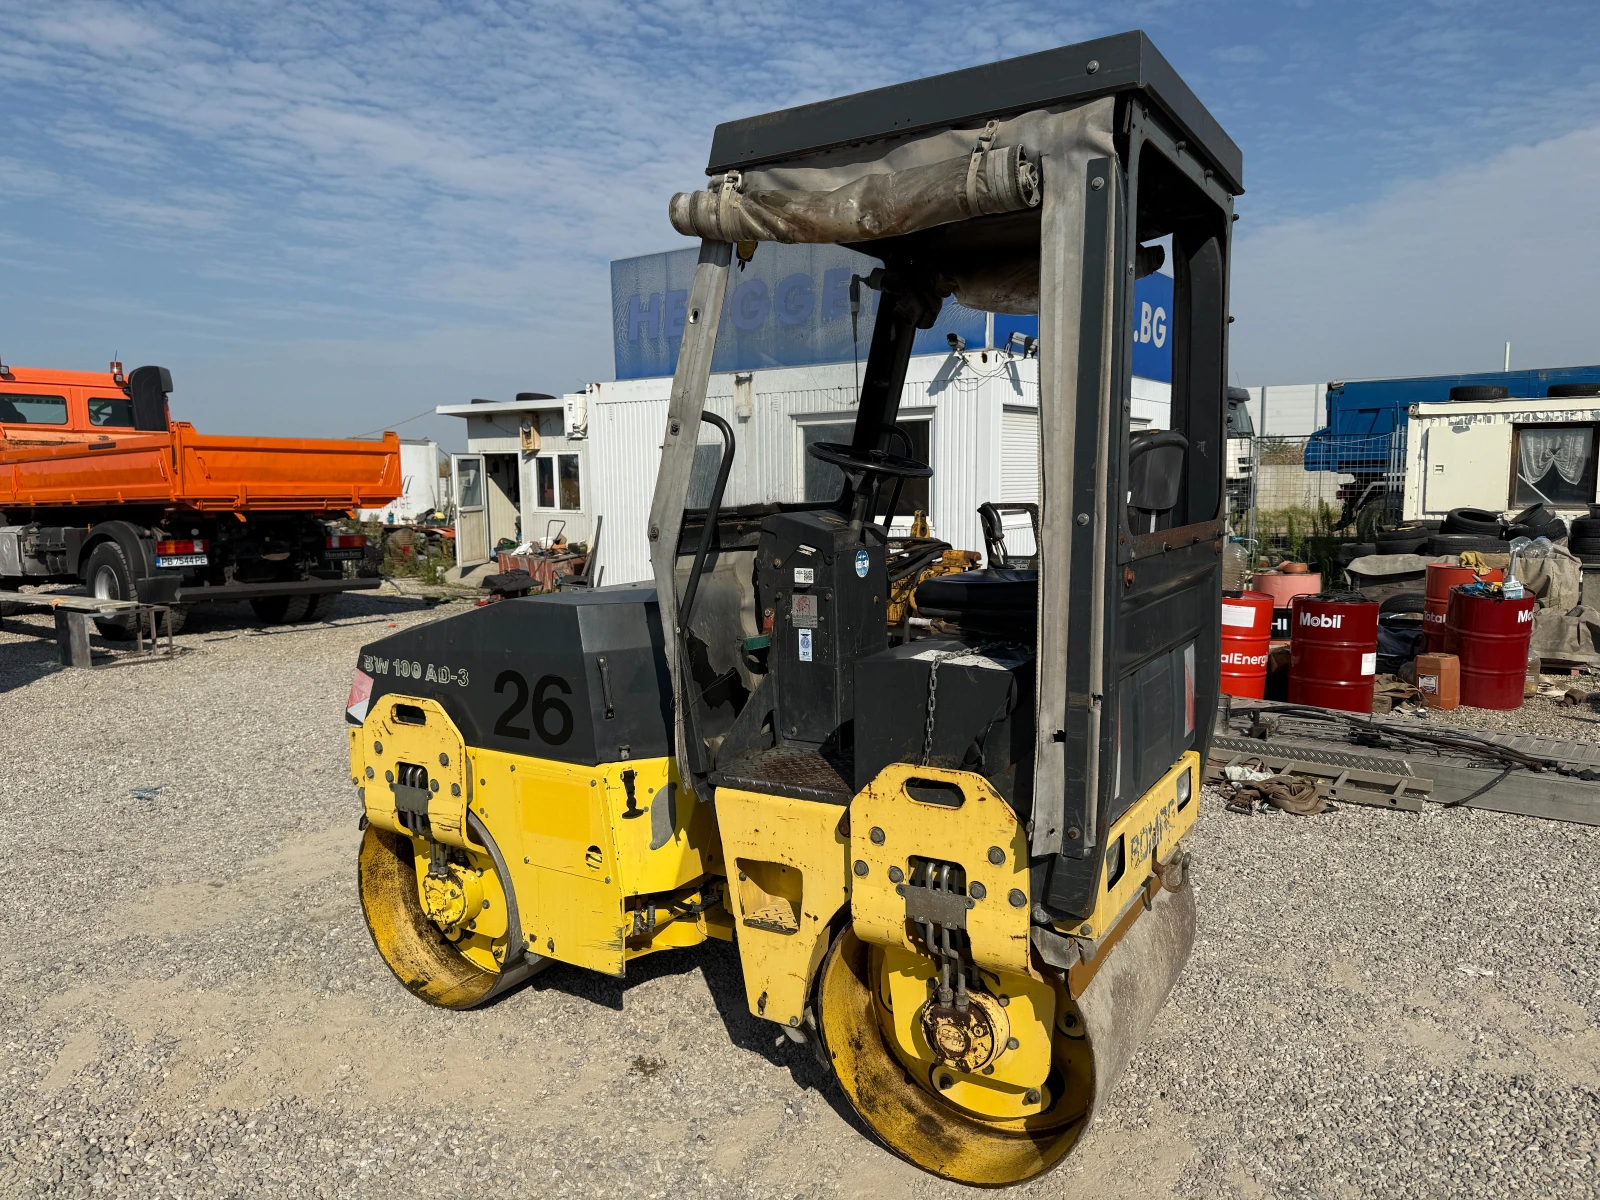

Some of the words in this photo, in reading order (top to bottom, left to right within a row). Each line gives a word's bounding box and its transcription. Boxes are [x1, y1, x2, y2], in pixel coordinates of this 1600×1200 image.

[1300, 611, 1342, 629] Mobil
[363, 655, 389, 675] BW
[393, 659, 422, 680] 100
[425, 663, 470, 687] AD-3
[493, 669, 574, 746] 26
